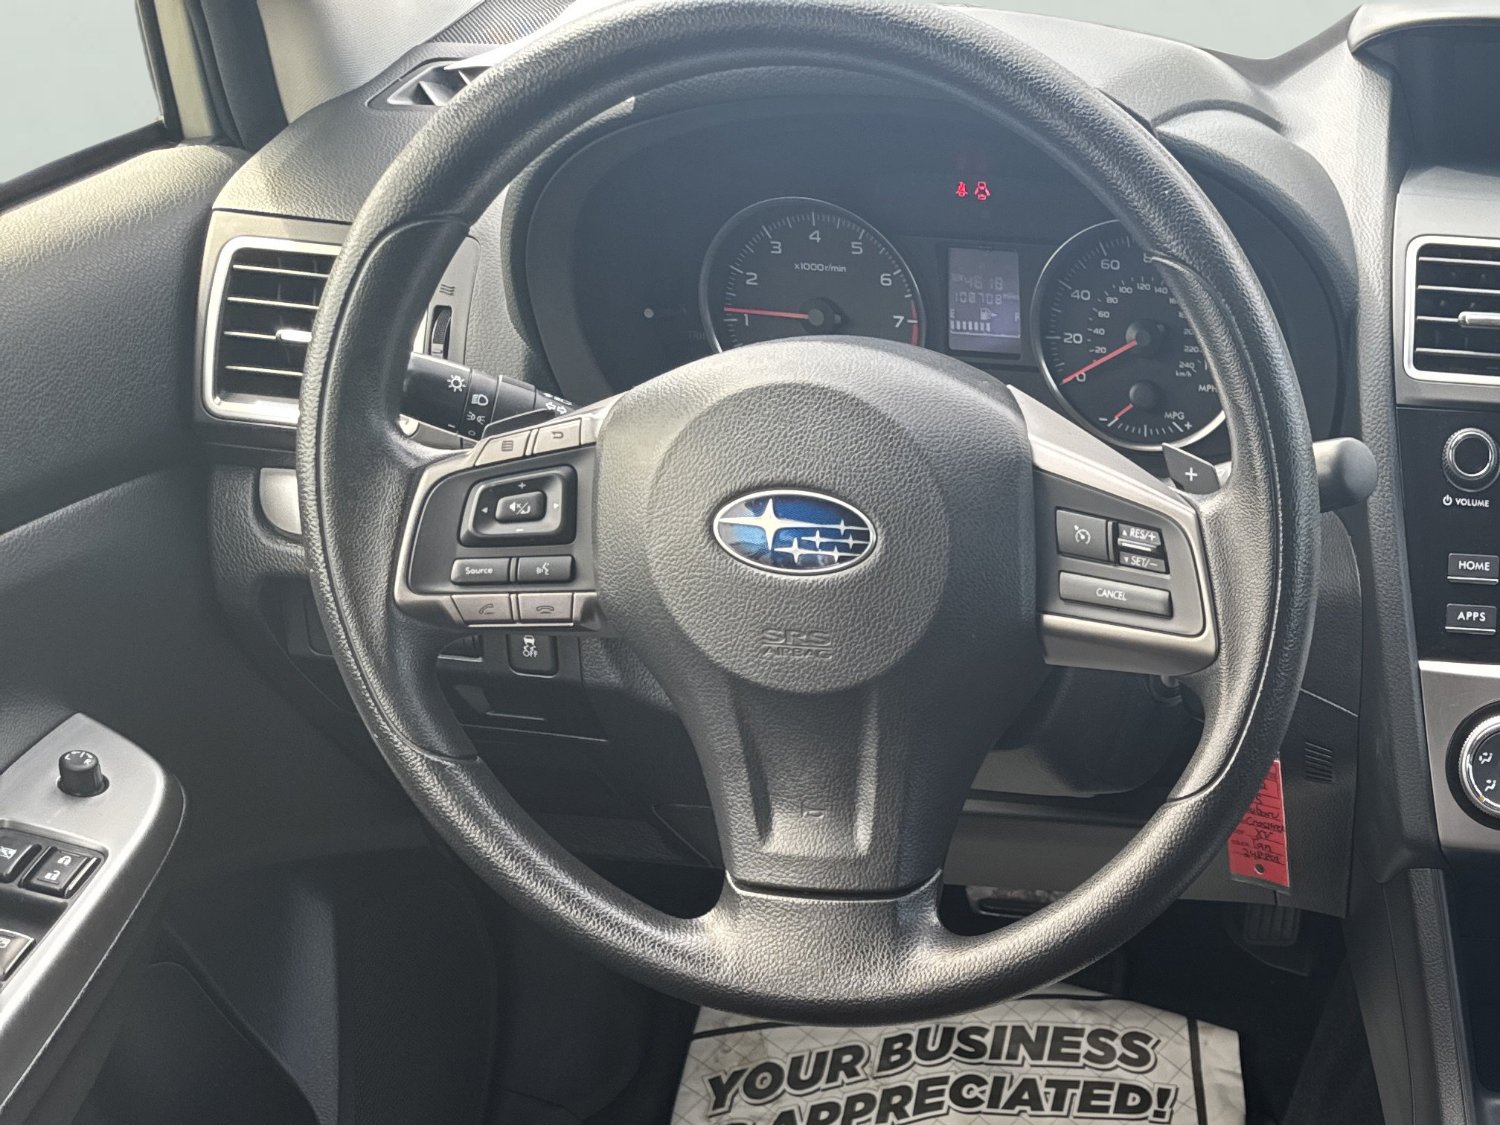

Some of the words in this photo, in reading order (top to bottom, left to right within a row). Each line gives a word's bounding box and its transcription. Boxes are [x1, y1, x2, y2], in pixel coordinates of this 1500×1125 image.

[808, 230, 821, 243] 4
[770, 241, 782, 254] 3
[851, 241, 863, 254] 5
[1100, 259, 1121, 271] 60
[745, 272, 758, 286] 2
[880, 273, 892, 286] 6
[1118, 286, 1133, 294] 100
[1136, 282, 1151, 291] 120
[1154, 286, 1168, 295] 140
[1070, 290, 1091, 301] 40
[1106, 296, 1118, 304] 80
[743, 313, 749, 326] 1
[893, 315, 905, 328] 7
[1093, 327, 1105, 335] 40
[1063, 332, 1083, 344] 20
[1095, 346, 1106, 354] 20
[1179, 361, 1195, 369] 240
[1164, 411, 1185, 421] MPG
[1455, 498, 1489, 507] VOLUME
[465, 566, 494, 575] Source
[1458, 560, 1490, 571] HOME
[1095, 587, 1127, 601] CANCEL
[1457, 611, 1486, 622] APPS
[761, 629, 832, 646] SRS
[522, 649, 538, 658] OFF
[706, 1043, 870, 1116] YOUR
[874, 1023, 1160, 1076] BUSINESS
